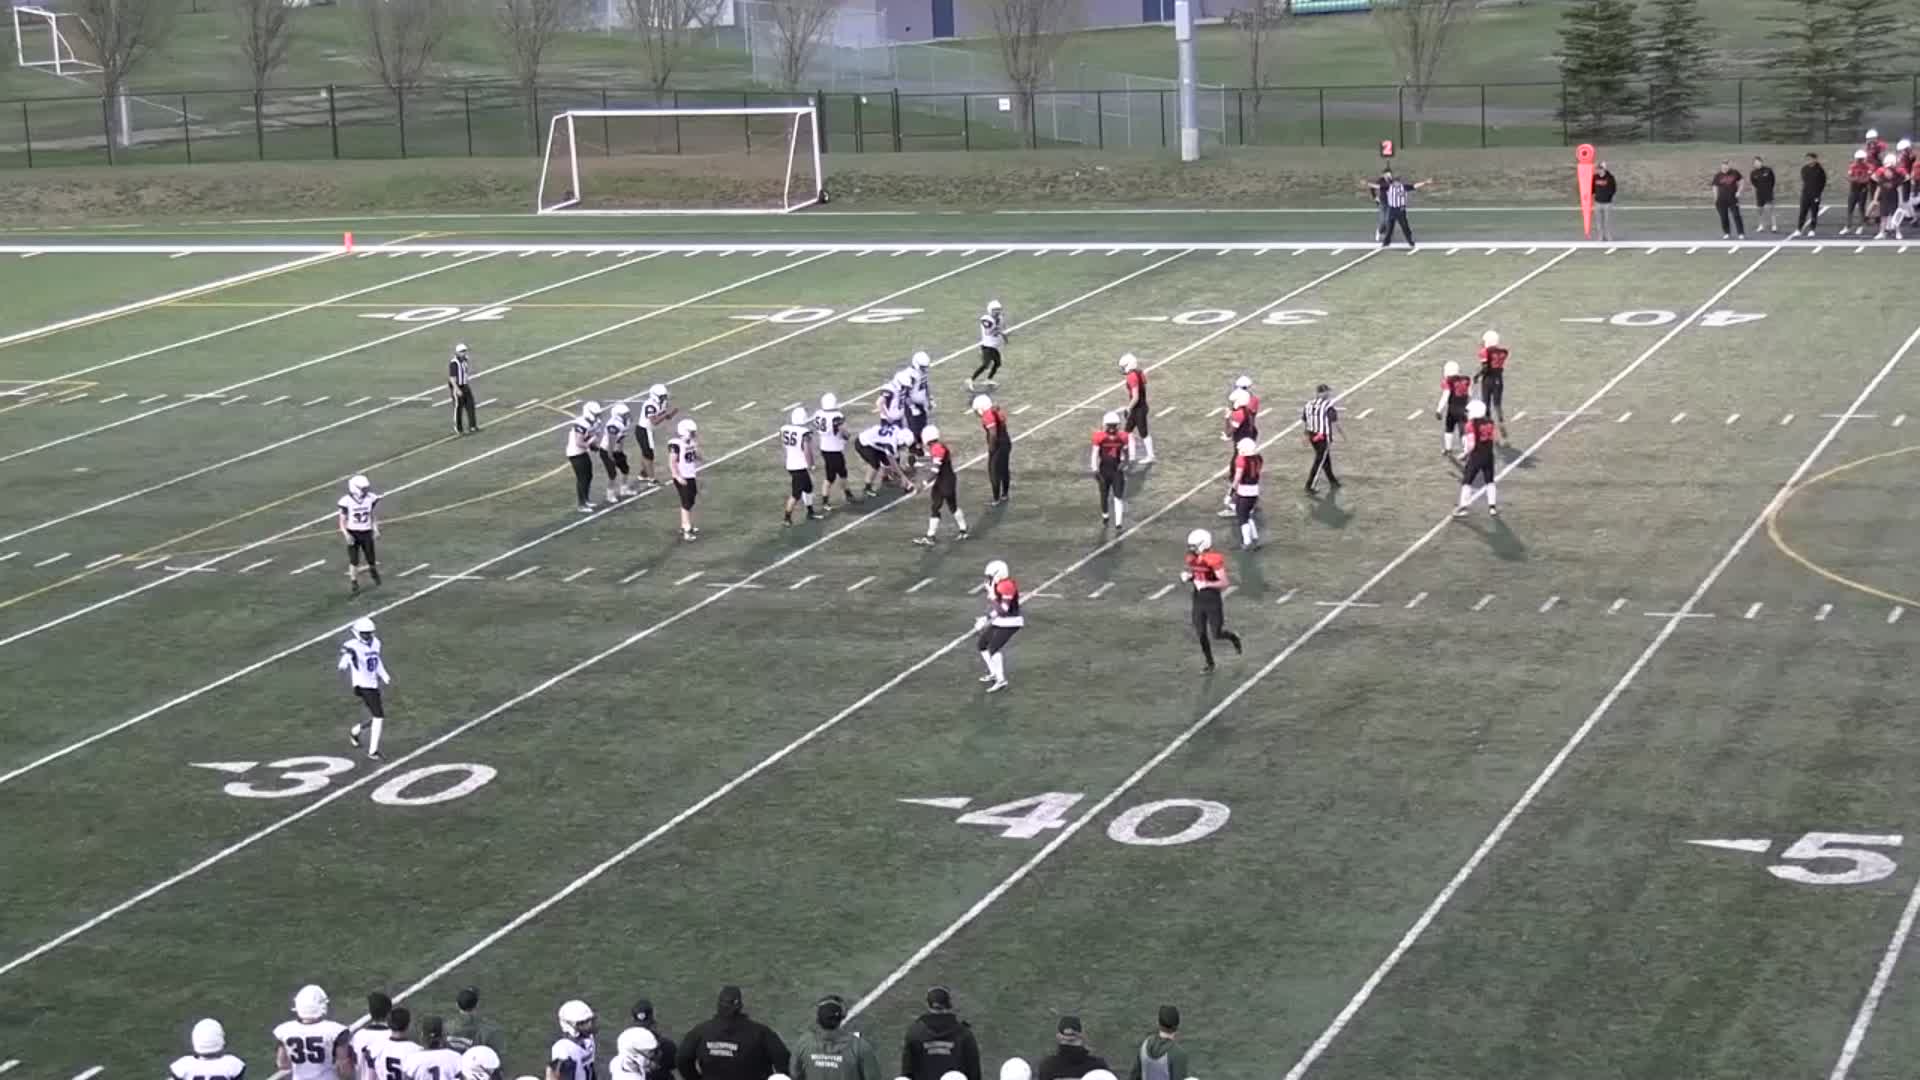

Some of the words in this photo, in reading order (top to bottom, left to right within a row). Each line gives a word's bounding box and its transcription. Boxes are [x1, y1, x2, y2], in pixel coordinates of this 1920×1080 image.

[1382, 140, 1392, 155] 2
[768, 307, 925, 323] 20
[1171, 309, 1329, 325] 30
[1610, 310, 1768, 326] 40
[223, 755, 498, 805] 30
[955, 792, 1231, 845] 40
[286, 1036, 325, 1064] 35
[385, 1056, 402, 1080] 5
